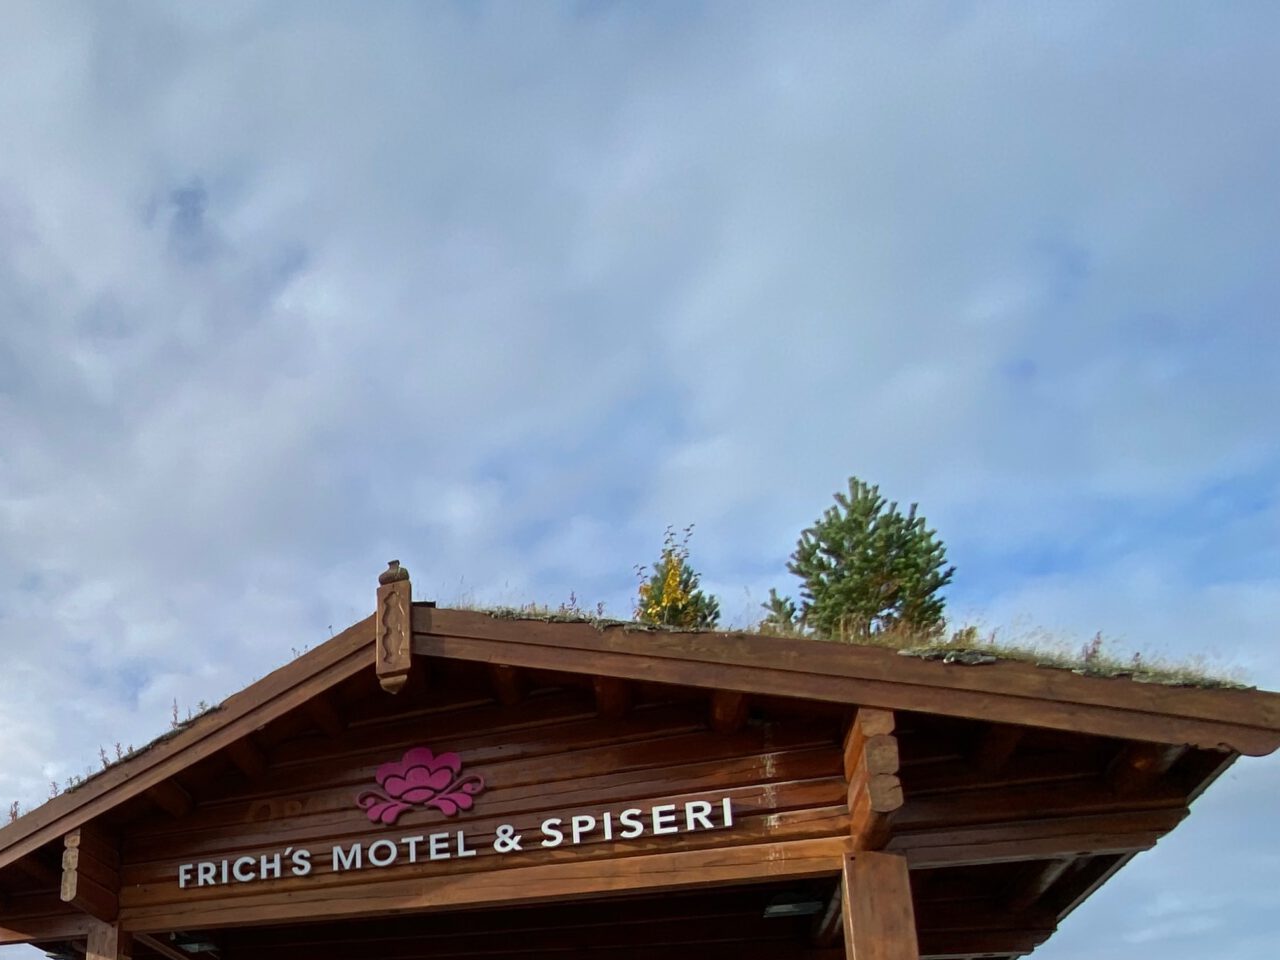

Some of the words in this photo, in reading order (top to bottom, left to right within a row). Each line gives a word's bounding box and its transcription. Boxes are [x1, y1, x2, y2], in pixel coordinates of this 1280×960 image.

[332, 830, 477, 871] MOTEL
[493, 824, 522, 853] &
[541, 797, 733, 848] SPISERI
